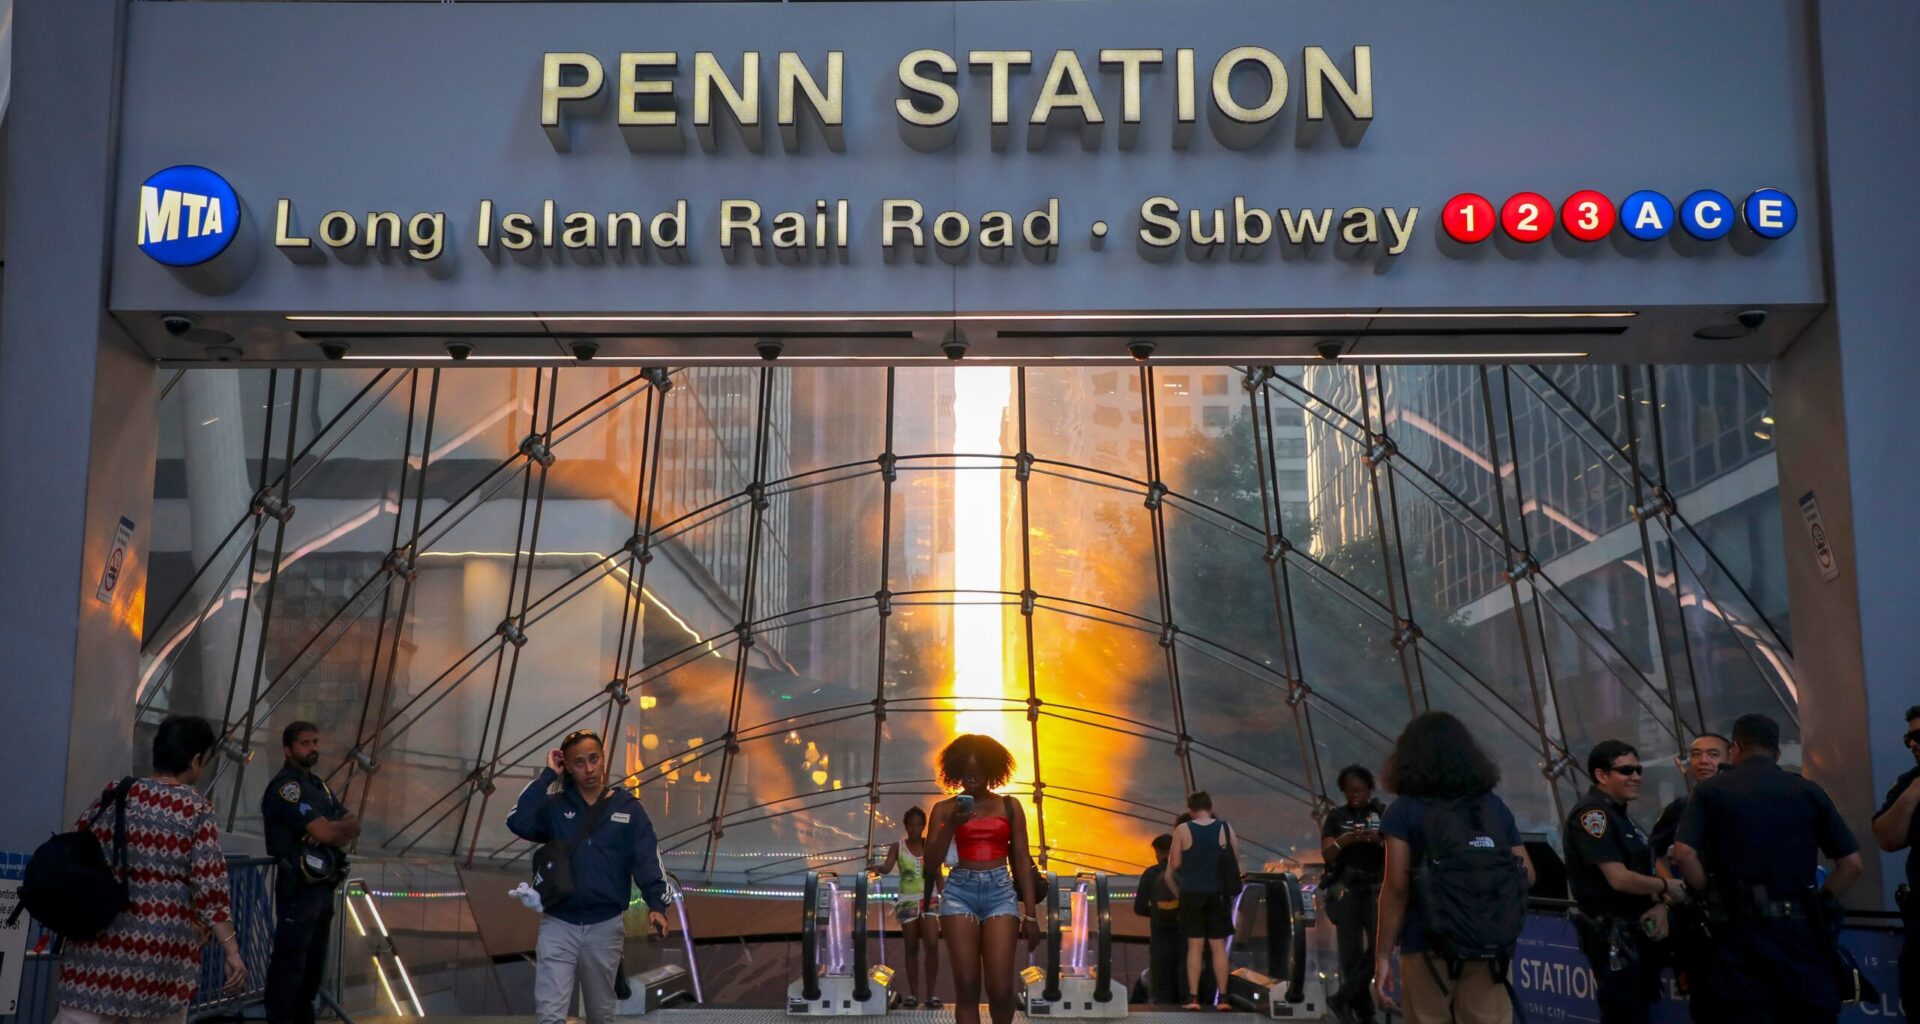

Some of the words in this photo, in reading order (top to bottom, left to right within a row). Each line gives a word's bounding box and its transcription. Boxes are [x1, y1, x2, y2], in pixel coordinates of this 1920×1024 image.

[540, 50, 844, 126] PENN
[895, 45, 1374, 126] STATION
[137, 185, 223, 245] MTA
[275, 198, 444, 260] Long
[478, 199, 687, 248] Island
[720, 199, 849, 248] Rail
[882, 198, 1058, 247] Road
[1140, 196, 1419, 255] Subway
[1634, 200, 1664, 229] A
[1693, 199, 1723, 229] C
[1758, 198, 1784, 228] E
